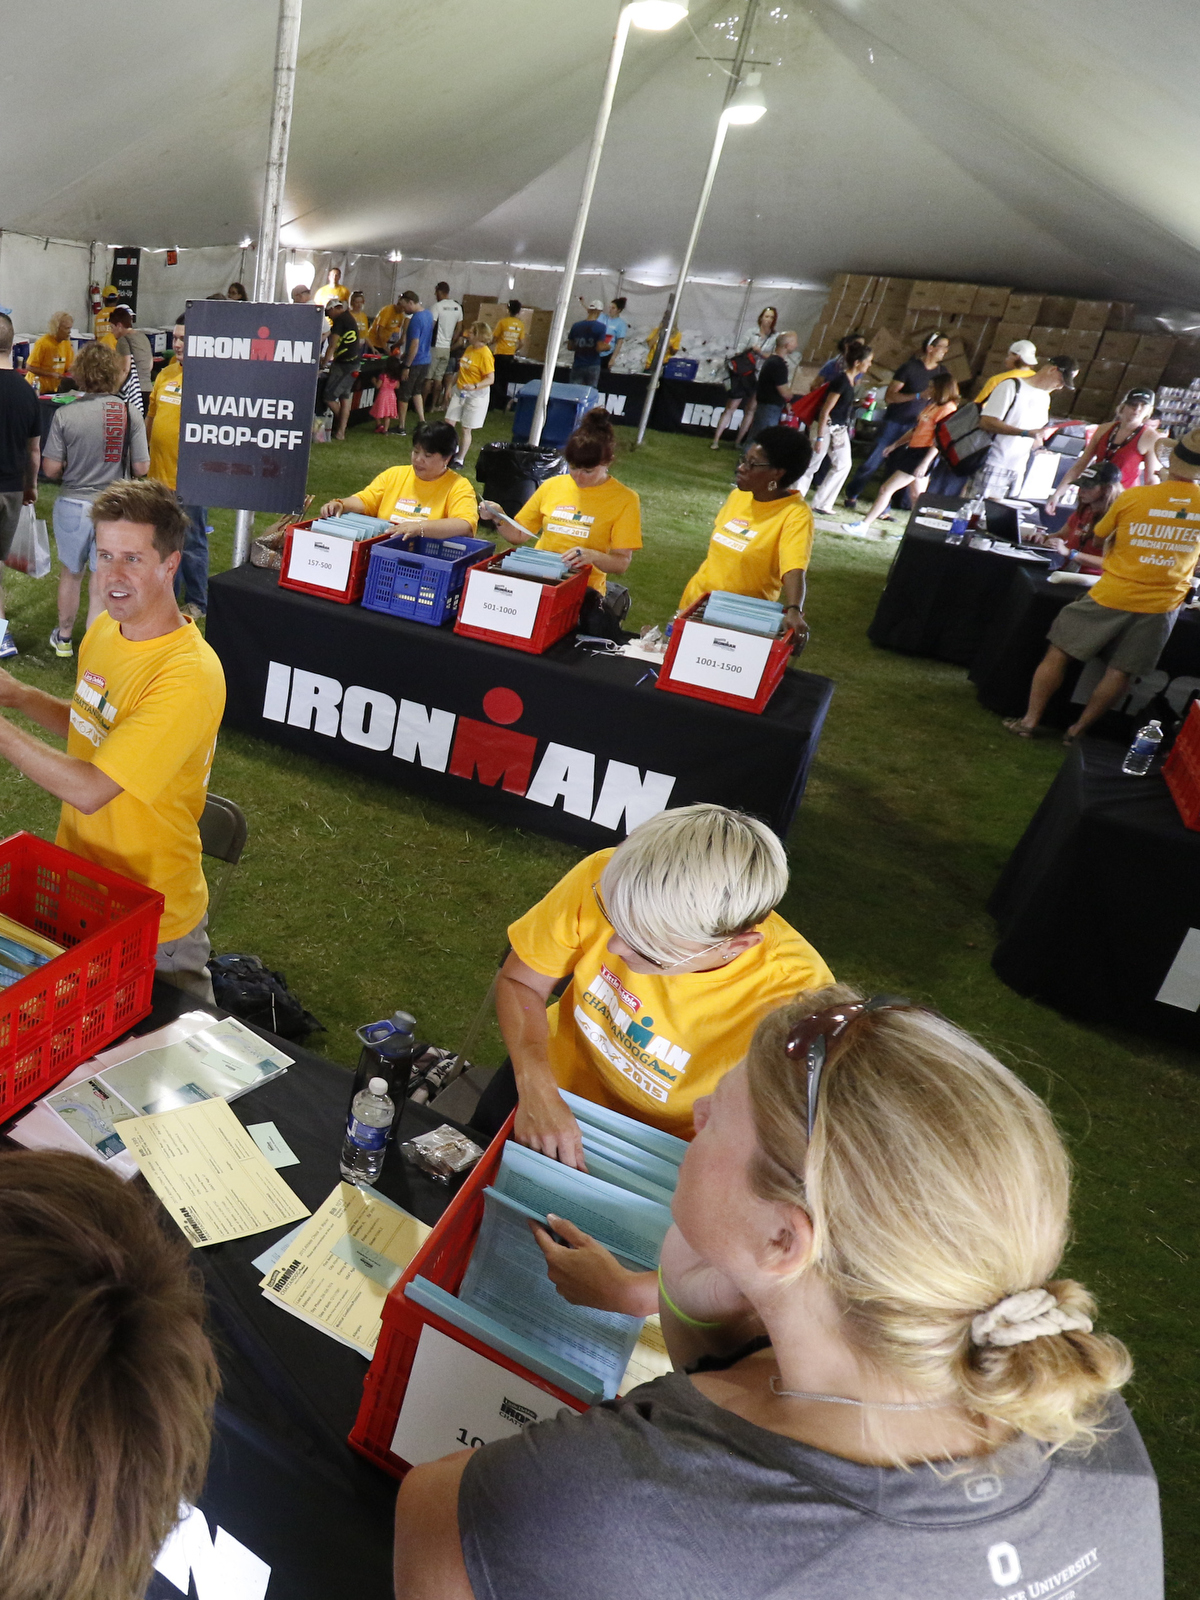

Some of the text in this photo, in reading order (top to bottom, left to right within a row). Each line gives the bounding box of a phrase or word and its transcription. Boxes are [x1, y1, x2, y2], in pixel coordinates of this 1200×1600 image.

[187, 326, 314, 364] IRONMAN
[197, 394, 295, 420] WAIVER
[104, 401, 123, 463] FINISHER
[185, 423, 303, 450] DROP-OFF
[1129, 522, 1200, 543] VOLUNTEE
[307, 559, 332, 570] 157-500
[483, 602, 517, 616] 501-1000
[695, 656, 743, 674] 1001-1500
[262, 660, 676, 836] IRONMAN
[601, 968, 620, 989] Little
[588, 974, 692, 1072] IRONMAN
[622, 1062, 664, 1100] 2015
[272, 1259, 302, 1293] IRONMAN
[456, 1427, 486, 1448] 10
